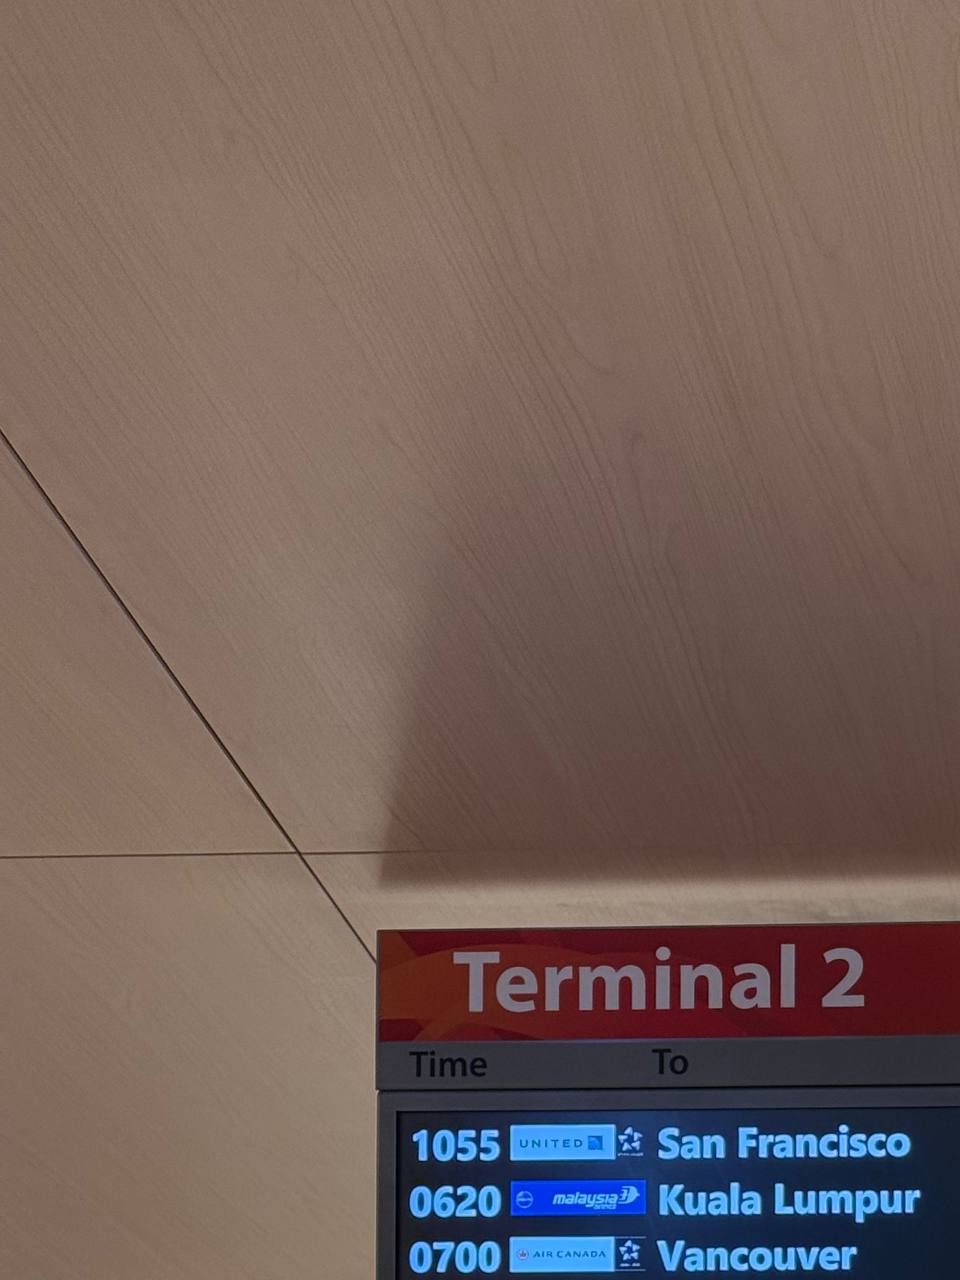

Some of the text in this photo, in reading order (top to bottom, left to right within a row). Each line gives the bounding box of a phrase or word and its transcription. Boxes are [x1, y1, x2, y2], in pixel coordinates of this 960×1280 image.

[453, 944, 864, 1012] Terminal 2
[410, 1051, 487, 1077] Time
[652, 1049, 688, 1074] To
[413, 1130, 500, 1161] 1055
[520, 1139, 583, 1149] UNITED
[658, 1125, 911, 1159] San Francisco
[410, 1185, 501, 1218] 0620
[552, 1192, 618, 1208] malaysia
[659, 1182, 921, 1223] Kuala Lumpur
[410, 1241, 501, 1273] 0700
[657, 1240, 857, 1271] Vancouver
